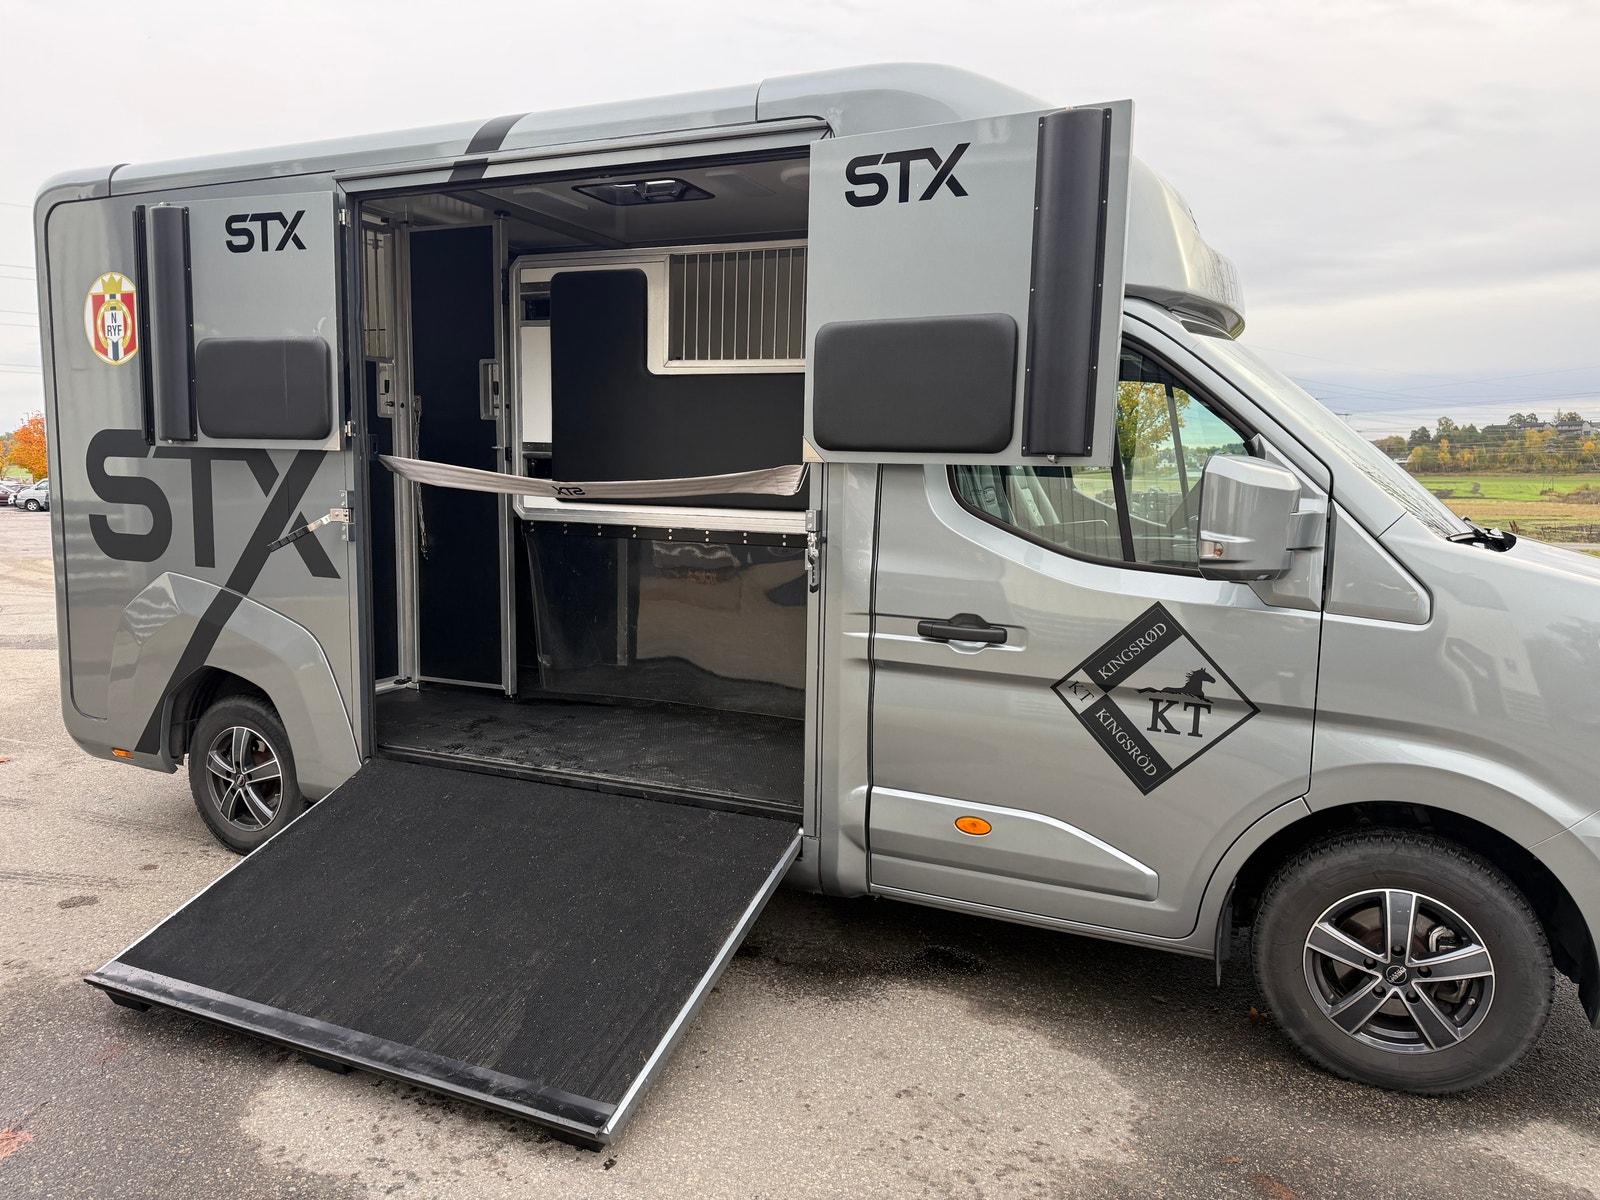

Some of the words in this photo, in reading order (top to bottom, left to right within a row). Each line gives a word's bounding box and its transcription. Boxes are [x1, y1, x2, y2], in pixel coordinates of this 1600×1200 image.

[845, 142, 971, 208] STX
[225, 210, 307, 253] STX
[107, 325, 122, 336] RYF
[110, 312, 117, 324] N
[86, 429, 341, 580] STX
[1097, 622, 1167, 680] KINGSRØD
[1068, 680, 1095, 702] KT
[1147, 697, 1212, 738] KT
[1094, 708, 1157, 776] KINGSRÖD
